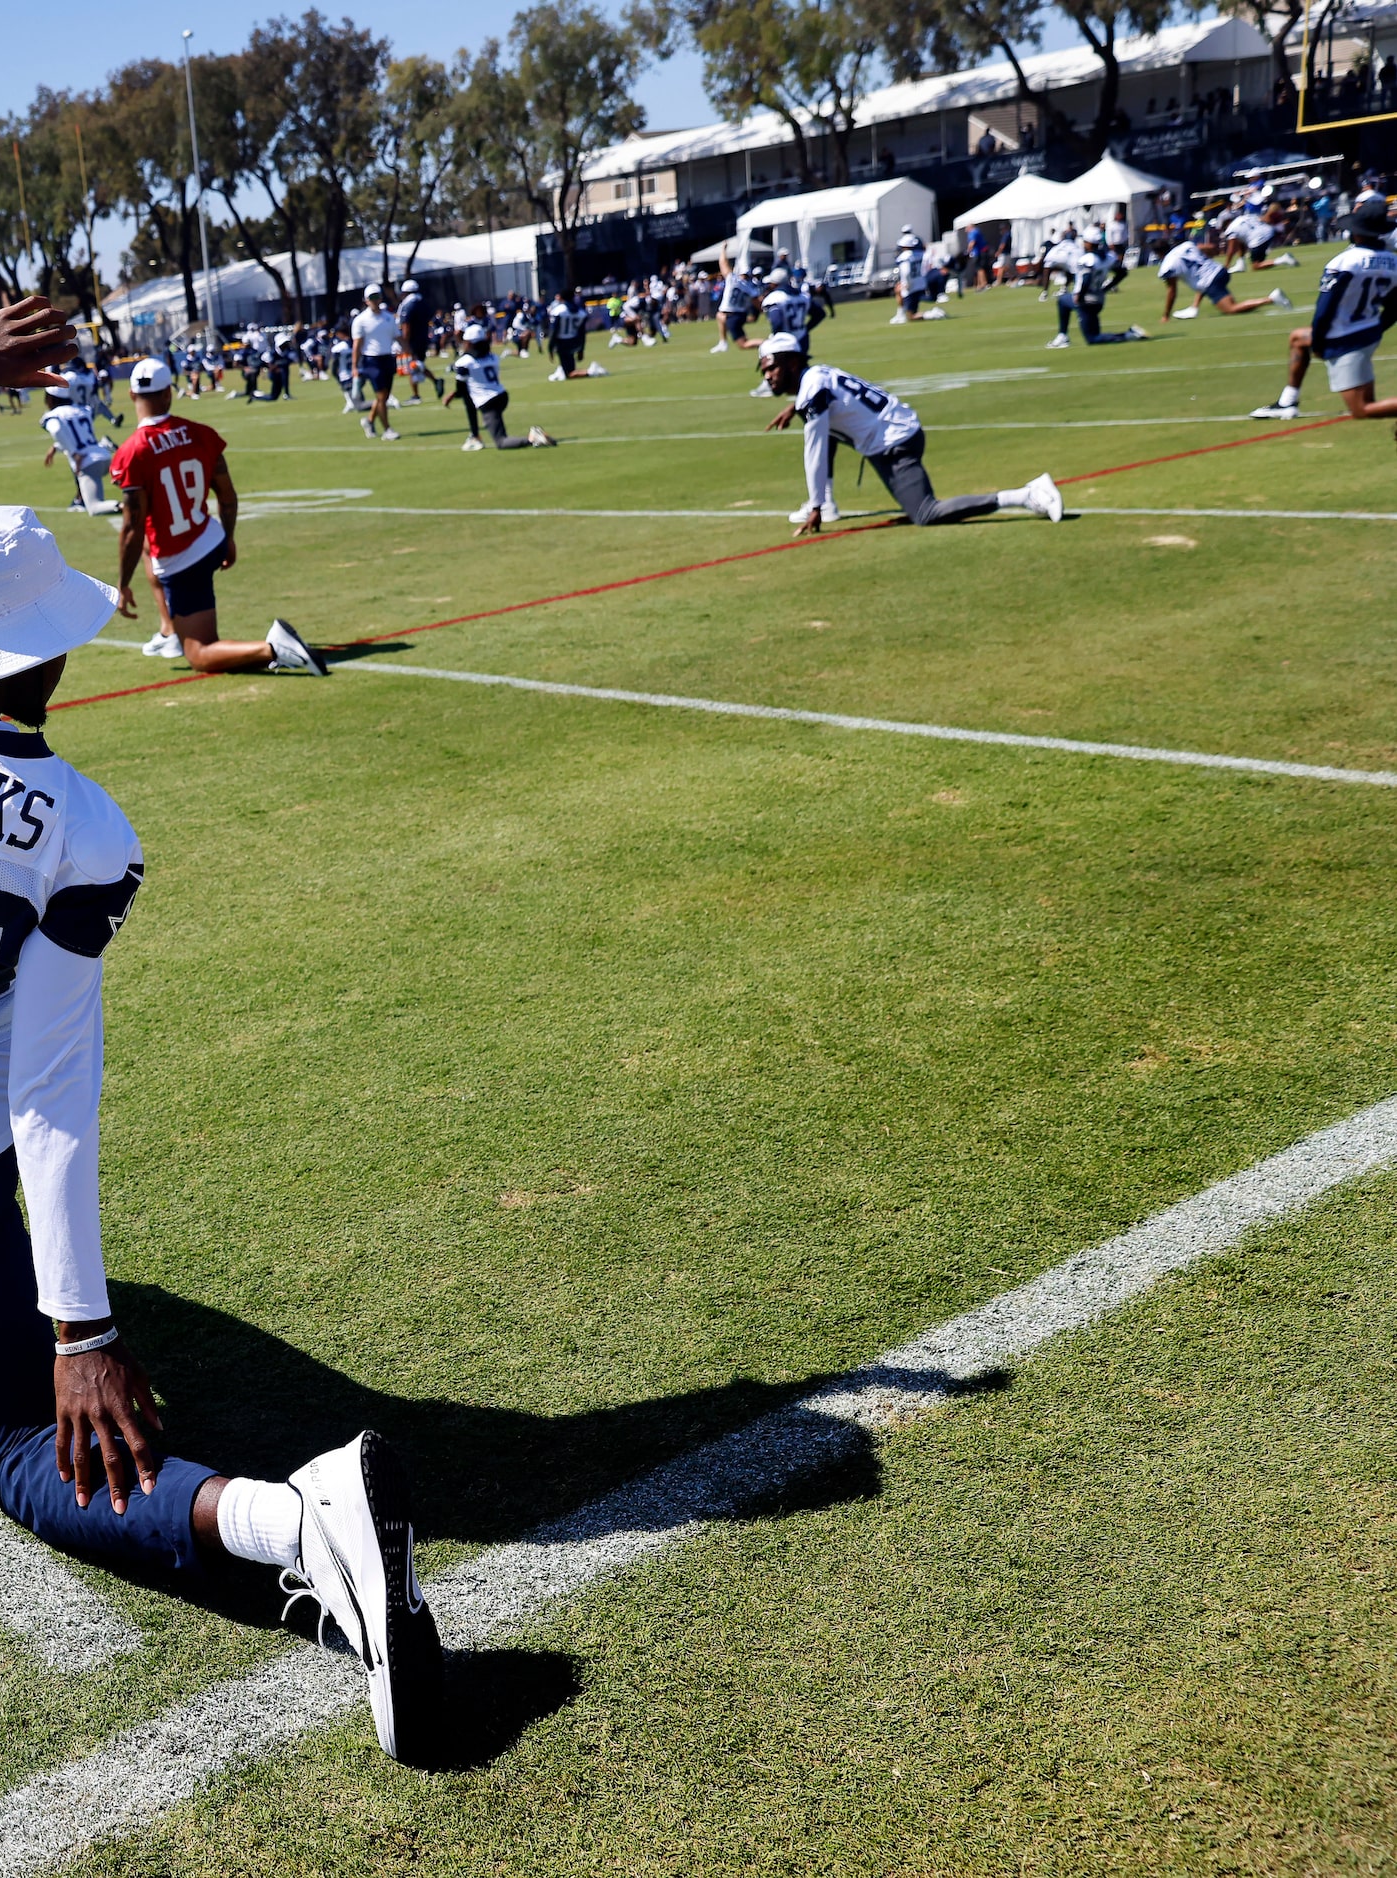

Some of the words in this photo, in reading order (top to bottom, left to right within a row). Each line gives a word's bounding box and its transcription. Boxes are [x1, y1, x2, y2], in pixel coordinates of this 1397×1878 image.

[67, 417, 99, 450] 13
[148, 426, 192, 454] LANCE
[160, 458, 205, 536] 19
[86, 1338, 104, 1349] FIGHT
